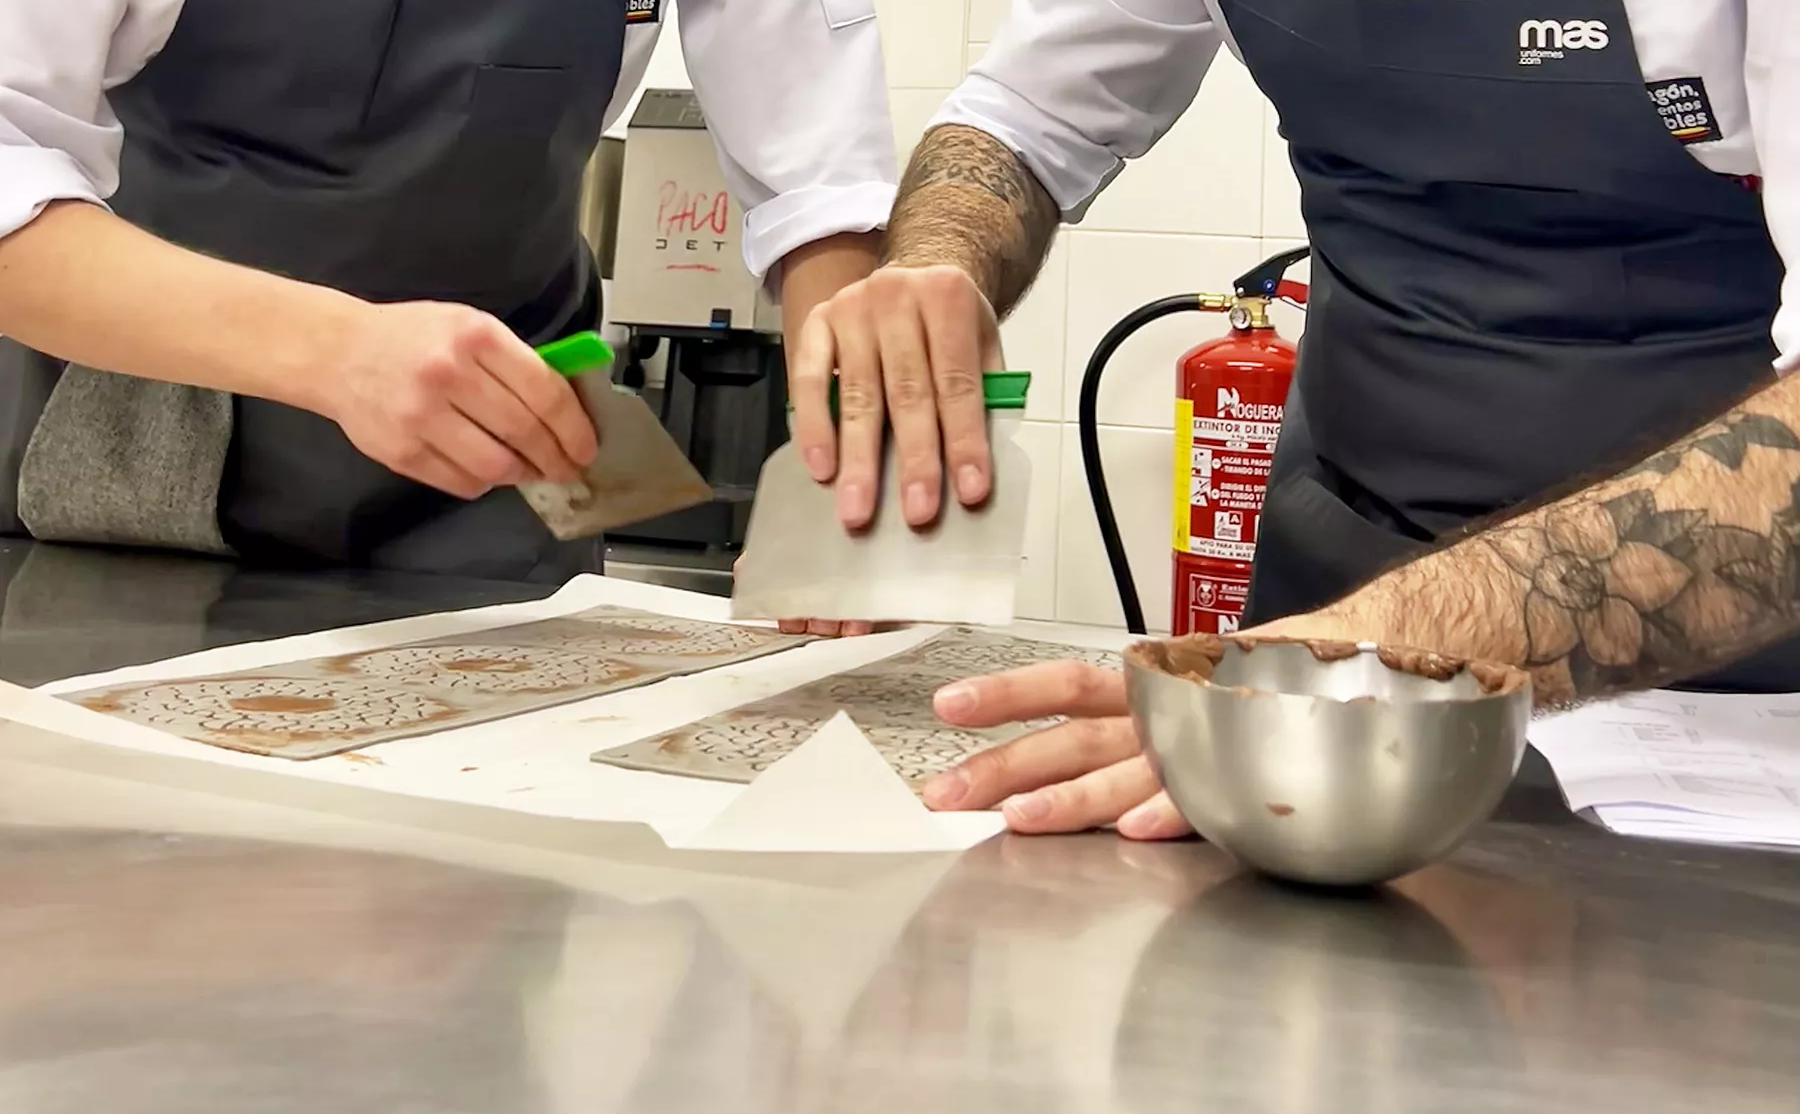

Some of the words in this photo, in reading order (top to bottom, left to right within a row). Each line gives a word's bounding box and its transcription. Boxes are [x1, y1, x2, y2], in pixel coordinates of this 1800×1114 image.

[1519, 19, 1609, 50] mas
[656, 180, 729, 238] PACO
[1193, 420, 1241, 433] EXTINTOR
[1245, 423, 1259, 434] DE
[1230, 514, 1240, 524] A
